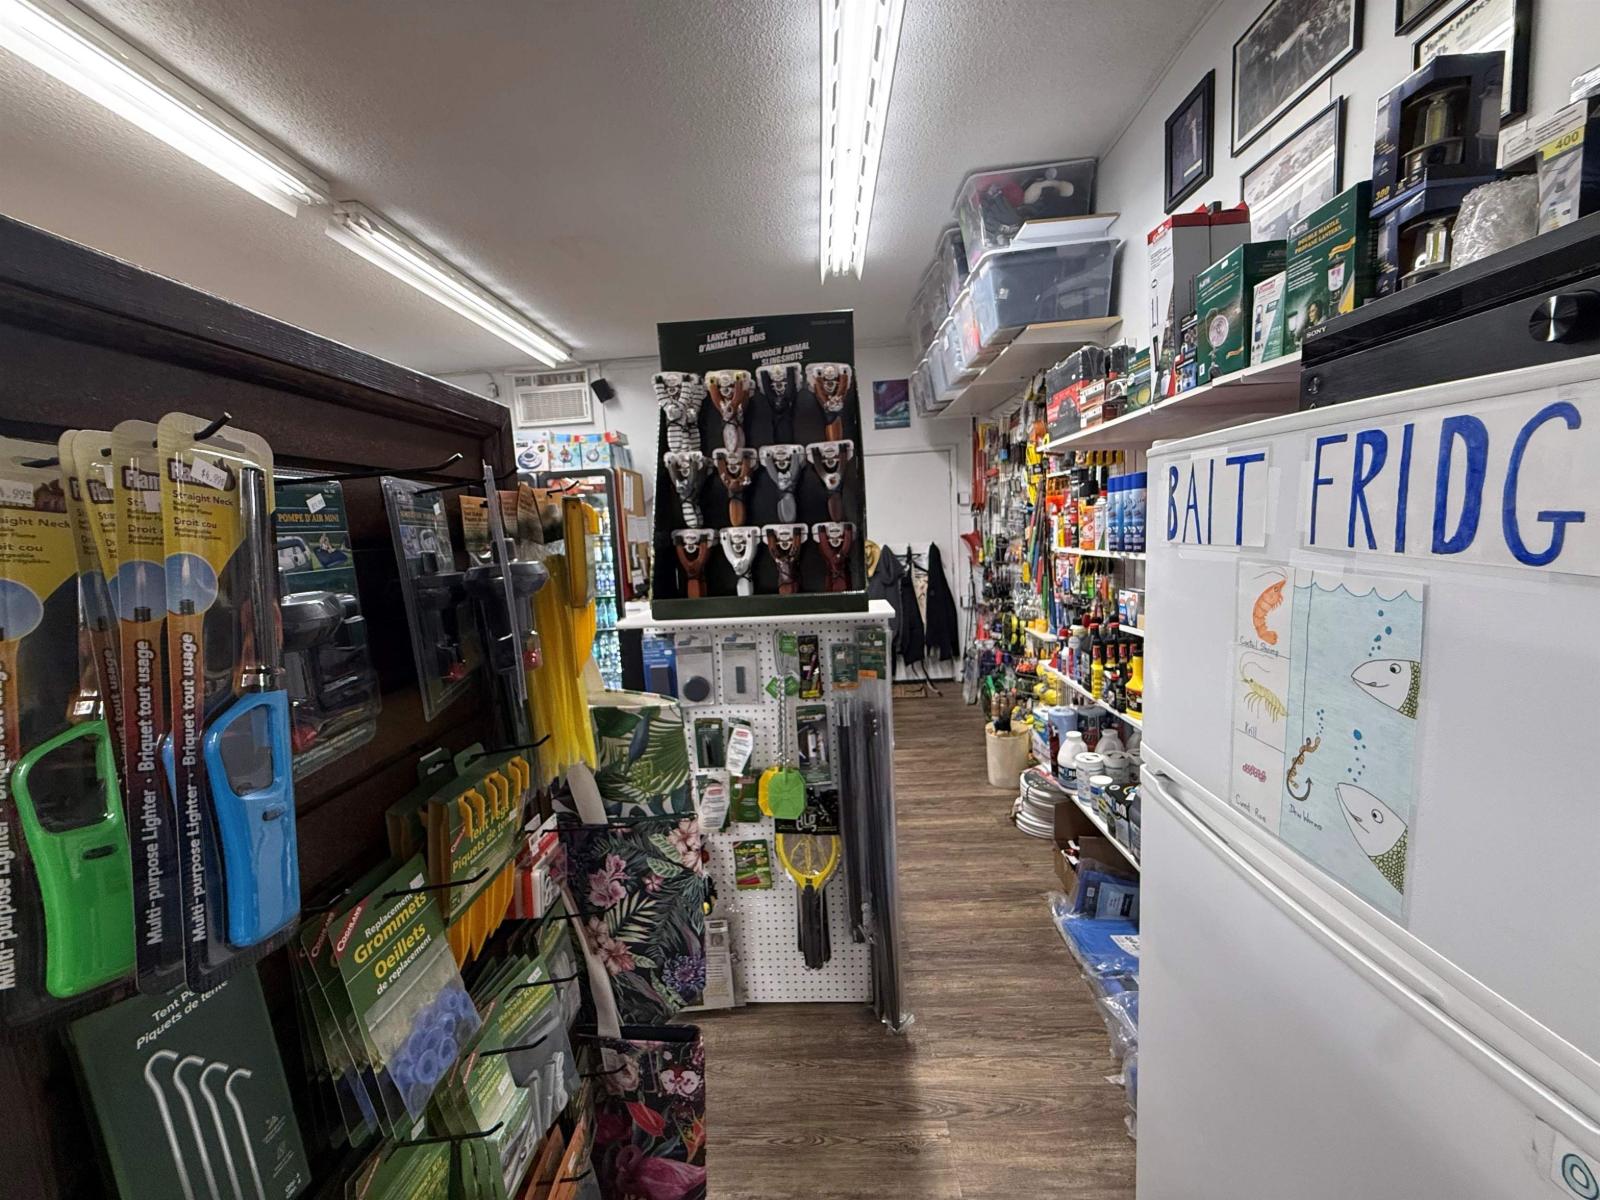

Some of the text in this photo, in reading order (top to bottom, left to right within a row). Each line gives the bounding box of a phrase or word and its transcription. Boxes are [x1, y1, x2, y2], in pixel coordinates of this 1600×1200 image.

[1555, 131, 1579, 149] 400
[707, 326, 754, 342] LANCE-PIERRE
[1306, 326, 1327, 338] SONY
[698, 337, 738, 353] D'ANIMAUX
[739, 335, 749, 345] EN
[752, 342, 810, 360] WOODEN ANIMAL
[761, 352, 803, 366] SLINGSHOTS
[172, 490, 234, 506] Straight Neck
[1167, 452, 1265, 547] BAIT
[38, 518, 71, 529] Neck
[174, 517, 217, 529] Droit cou
[278, 513, 340, 522] POMPE D'AIR MINI
[128, 524, 157, 534] Droit
[104, 650, 118, 689] usage
[137, 641, 164, 945] Multi-purpose Lighter Briquet tout usage
[182, 633, 206, 943] Multi-purpose Lighter Briquet tout usage
[451, 841, 486, 874] Piquets
[486, 828, 497, 842] de
[364, 893, 413, 938] Replacement
[354, 892, 427, 964] Grommets
[374, 923, 426, 979] Oeillets
[376, 934, 432, 995] de replacement
[152, 999, 181, 1021] Tent
[136, 1012, 183, 1050] Piquets
[184, 1000, 199, 1014] de
